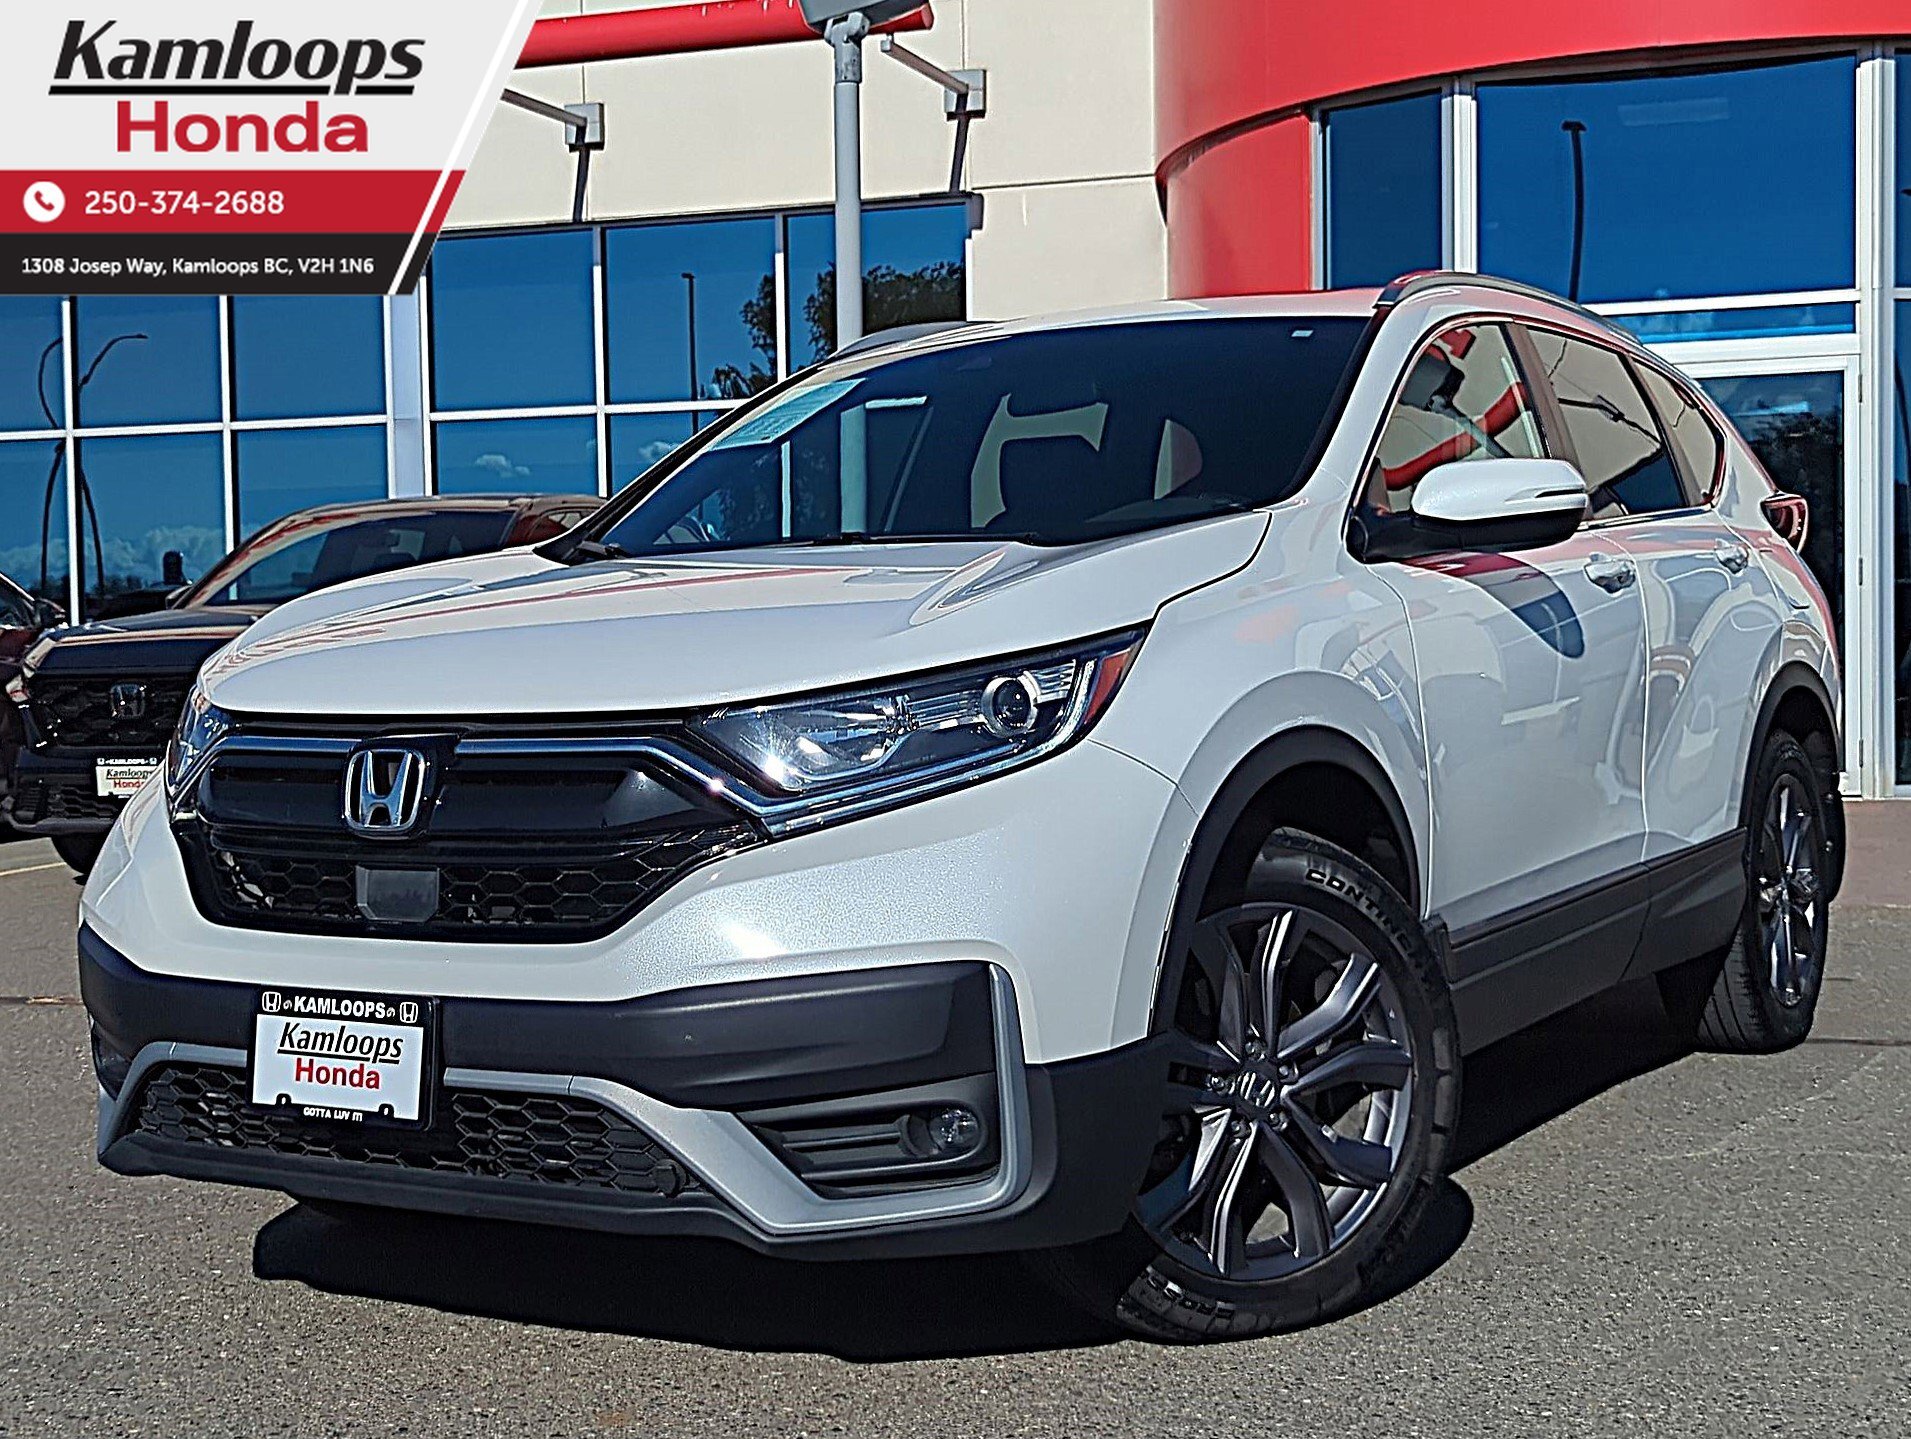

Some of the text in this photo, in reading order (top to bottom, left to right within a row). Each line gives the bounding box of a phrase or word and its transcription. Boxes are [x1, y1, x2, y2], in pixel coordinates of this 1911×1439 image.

[293, 995, 386, 1019] KAMLOOPS
[279, 1021, 404, 1063] Kamloops
[295, 1057, 381, 1090] Honda
[303, 1107, 332, 1119] GOTTA
[333, 1109, 351, 1121] LUV
